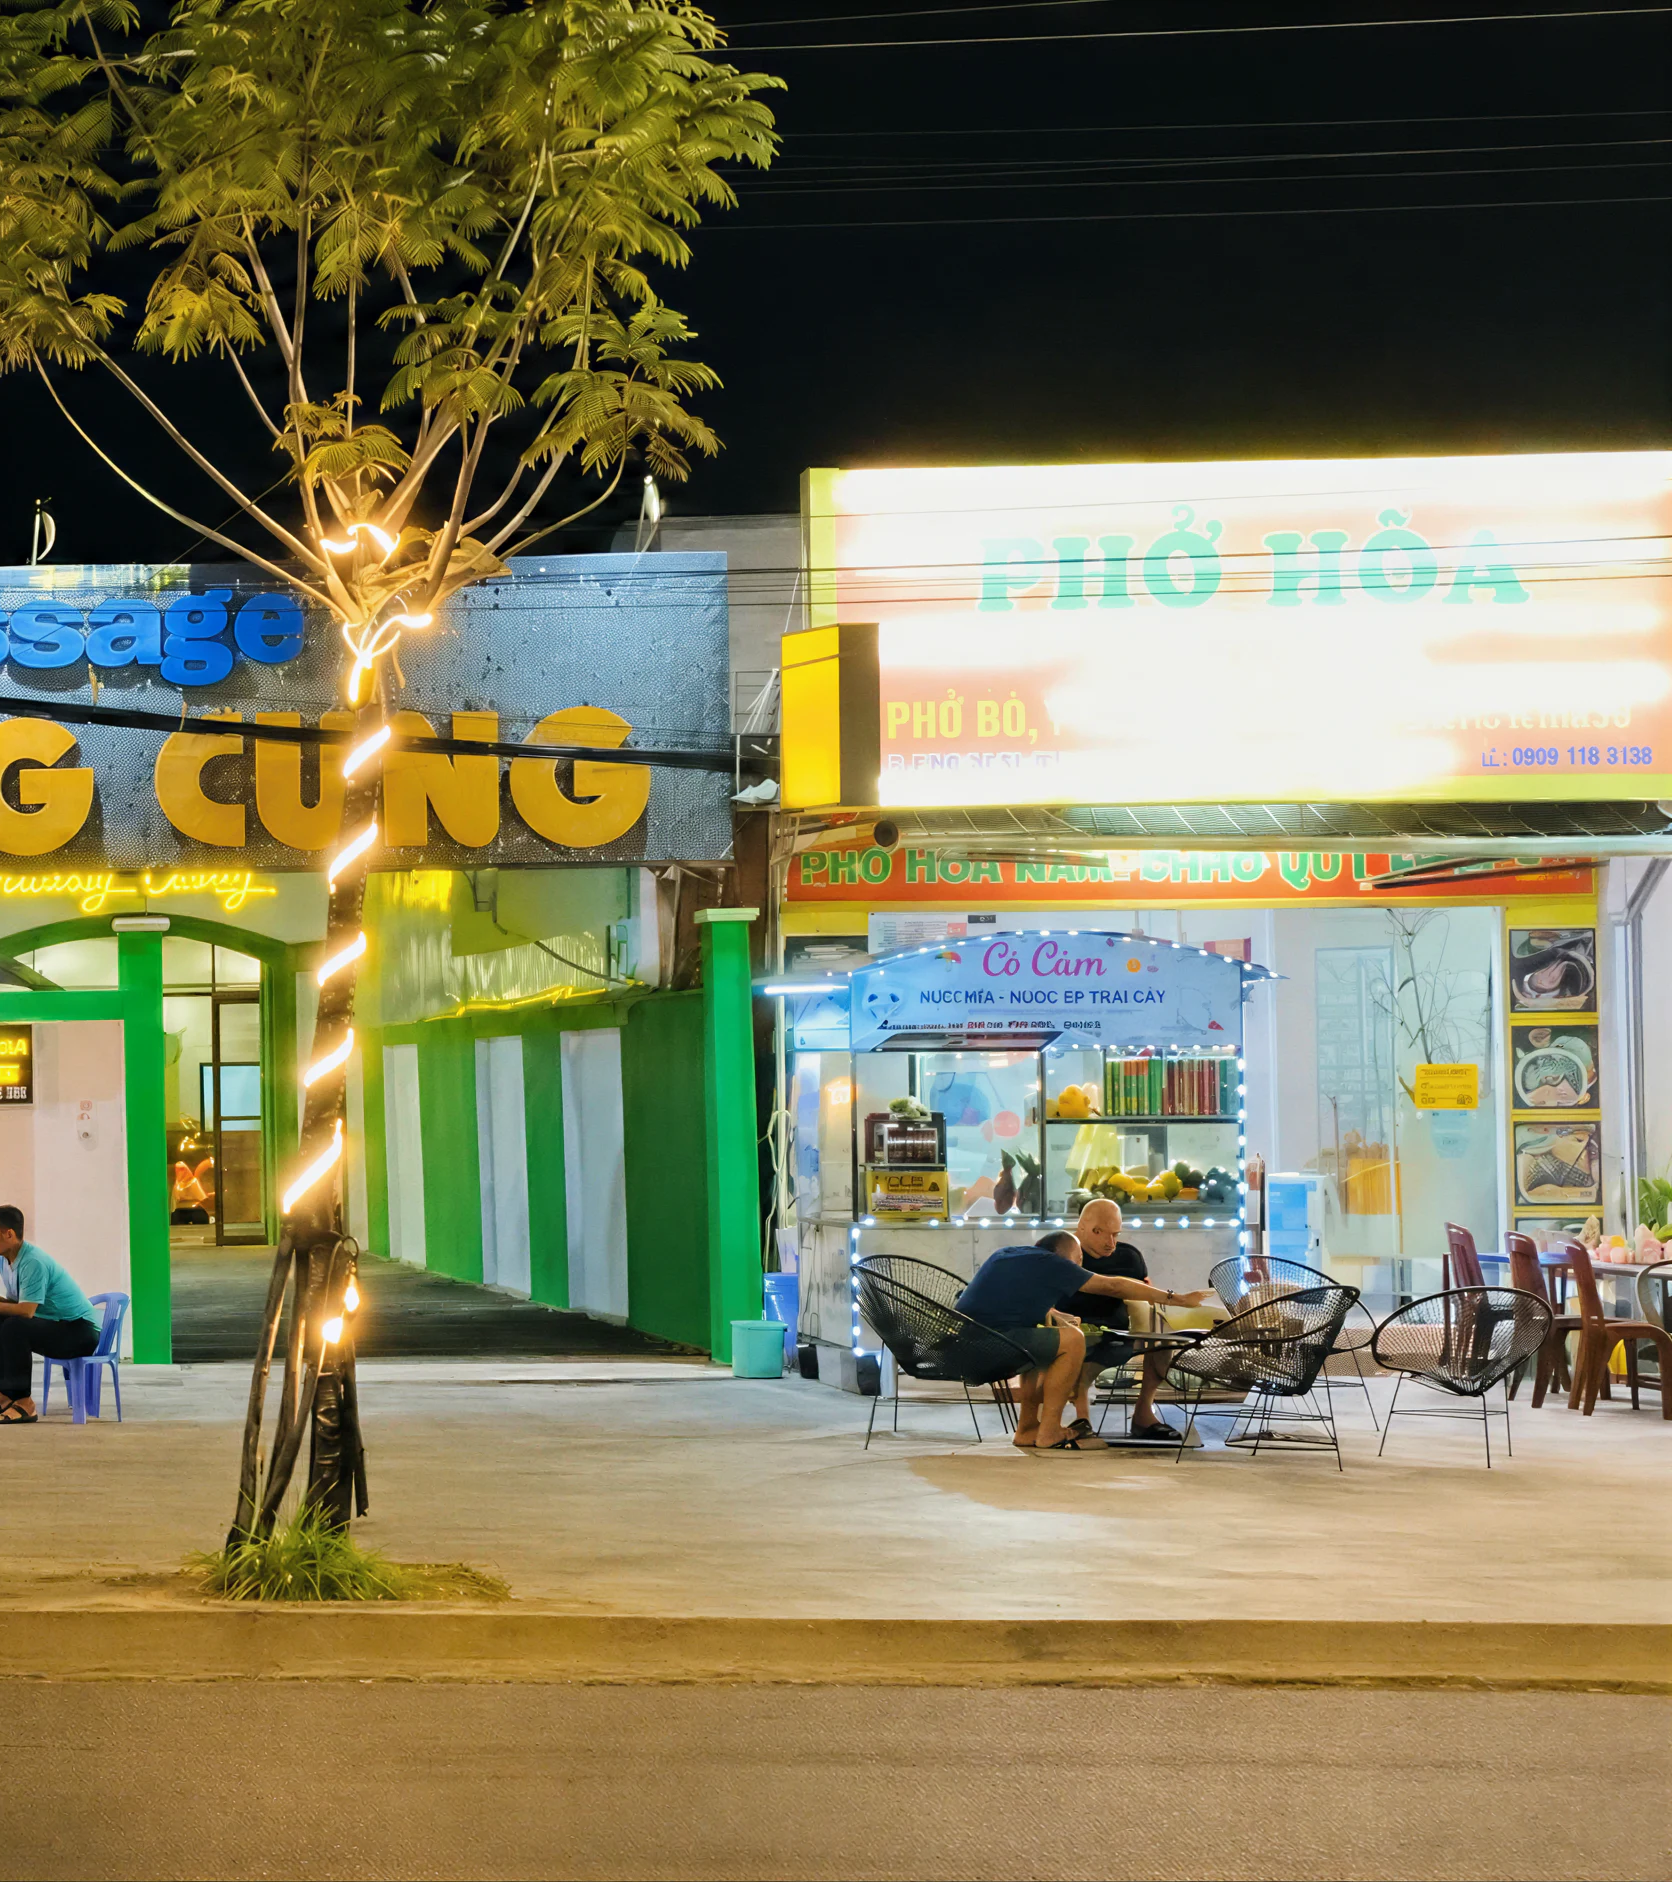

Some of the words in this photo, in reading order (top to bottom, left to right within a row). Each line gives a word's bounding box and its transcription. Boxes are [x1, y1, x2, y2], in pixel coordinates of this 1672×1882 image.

[1512, 746, 1559, 766] 0909
[1567, 745, 1600, 766] 118
[1606, 745, 1653, 766] 3138
